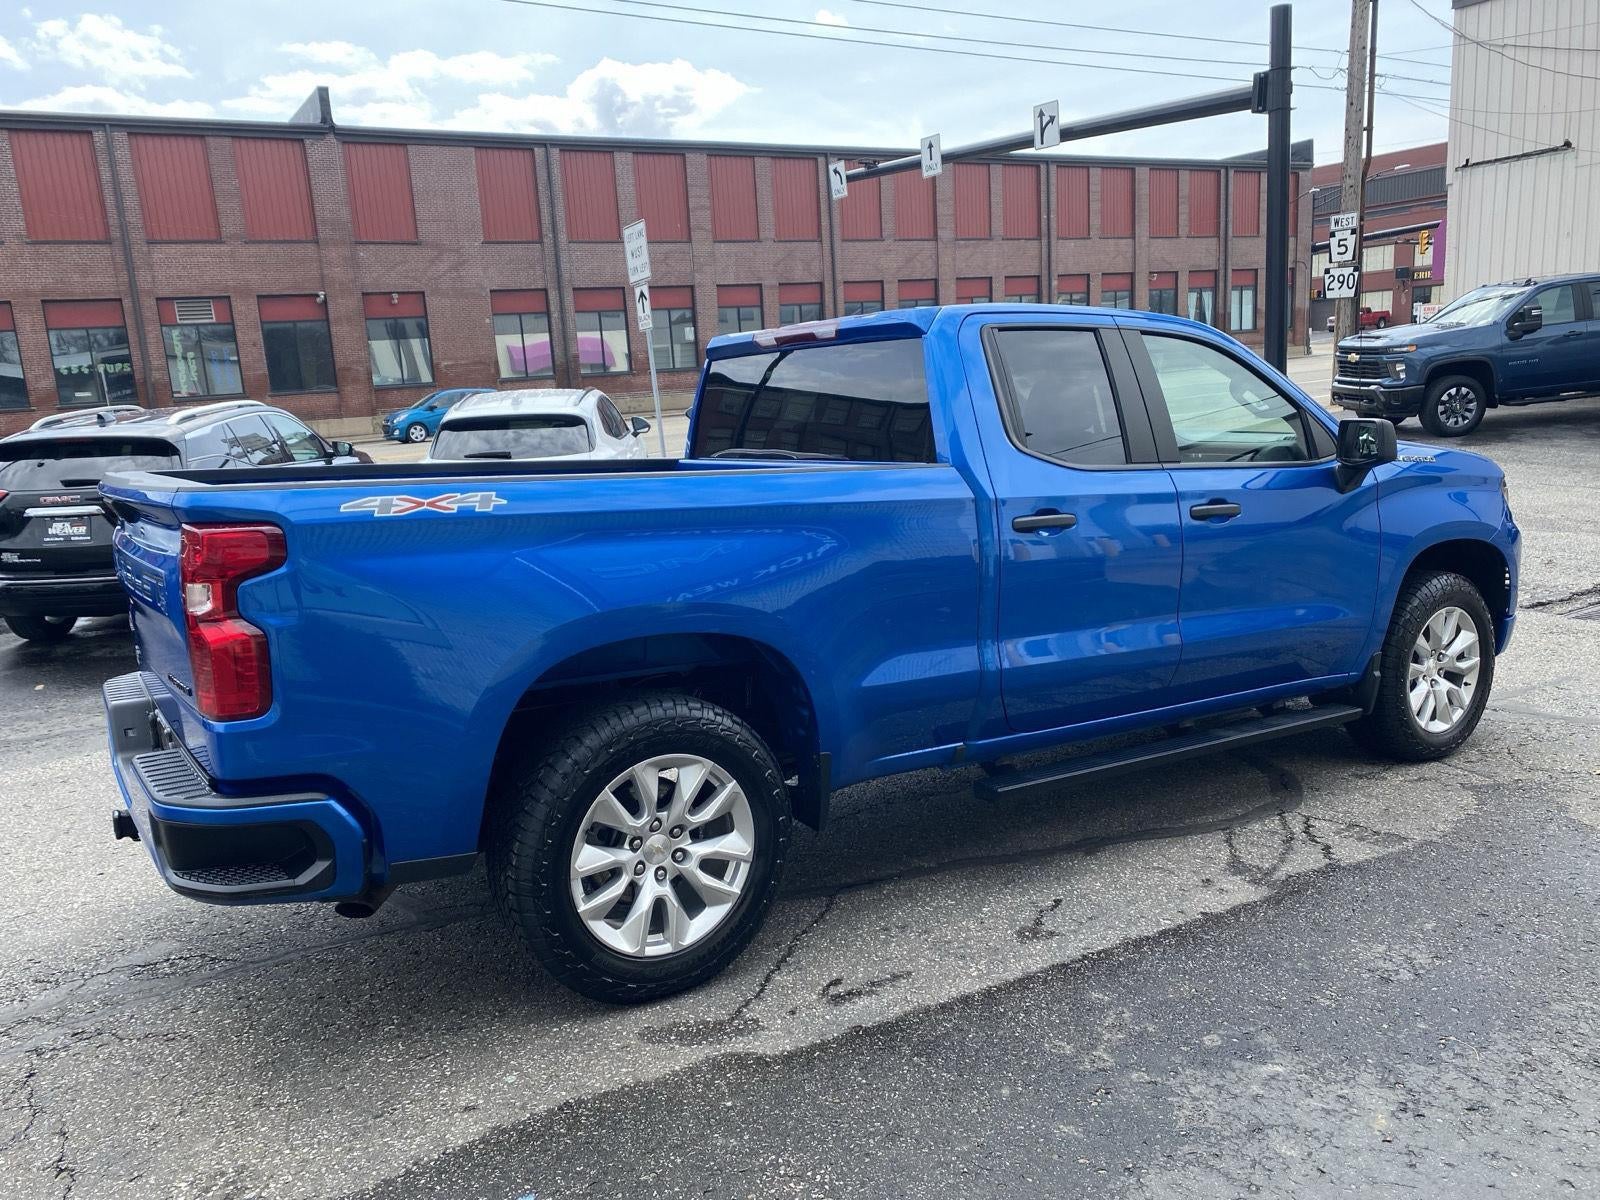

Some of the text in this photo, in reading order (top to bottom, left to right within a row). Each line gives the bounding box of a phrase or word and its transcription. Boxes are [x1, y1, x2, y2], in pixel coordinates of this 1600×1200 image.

[924, 162, 939, 173] ONLY
[1333, 216, 1355, 228] WEST
[1337, 238, 1349, 256] 5
[1327, 273, 1356, 291] 290
[39, 495, 81, 504] GMC
